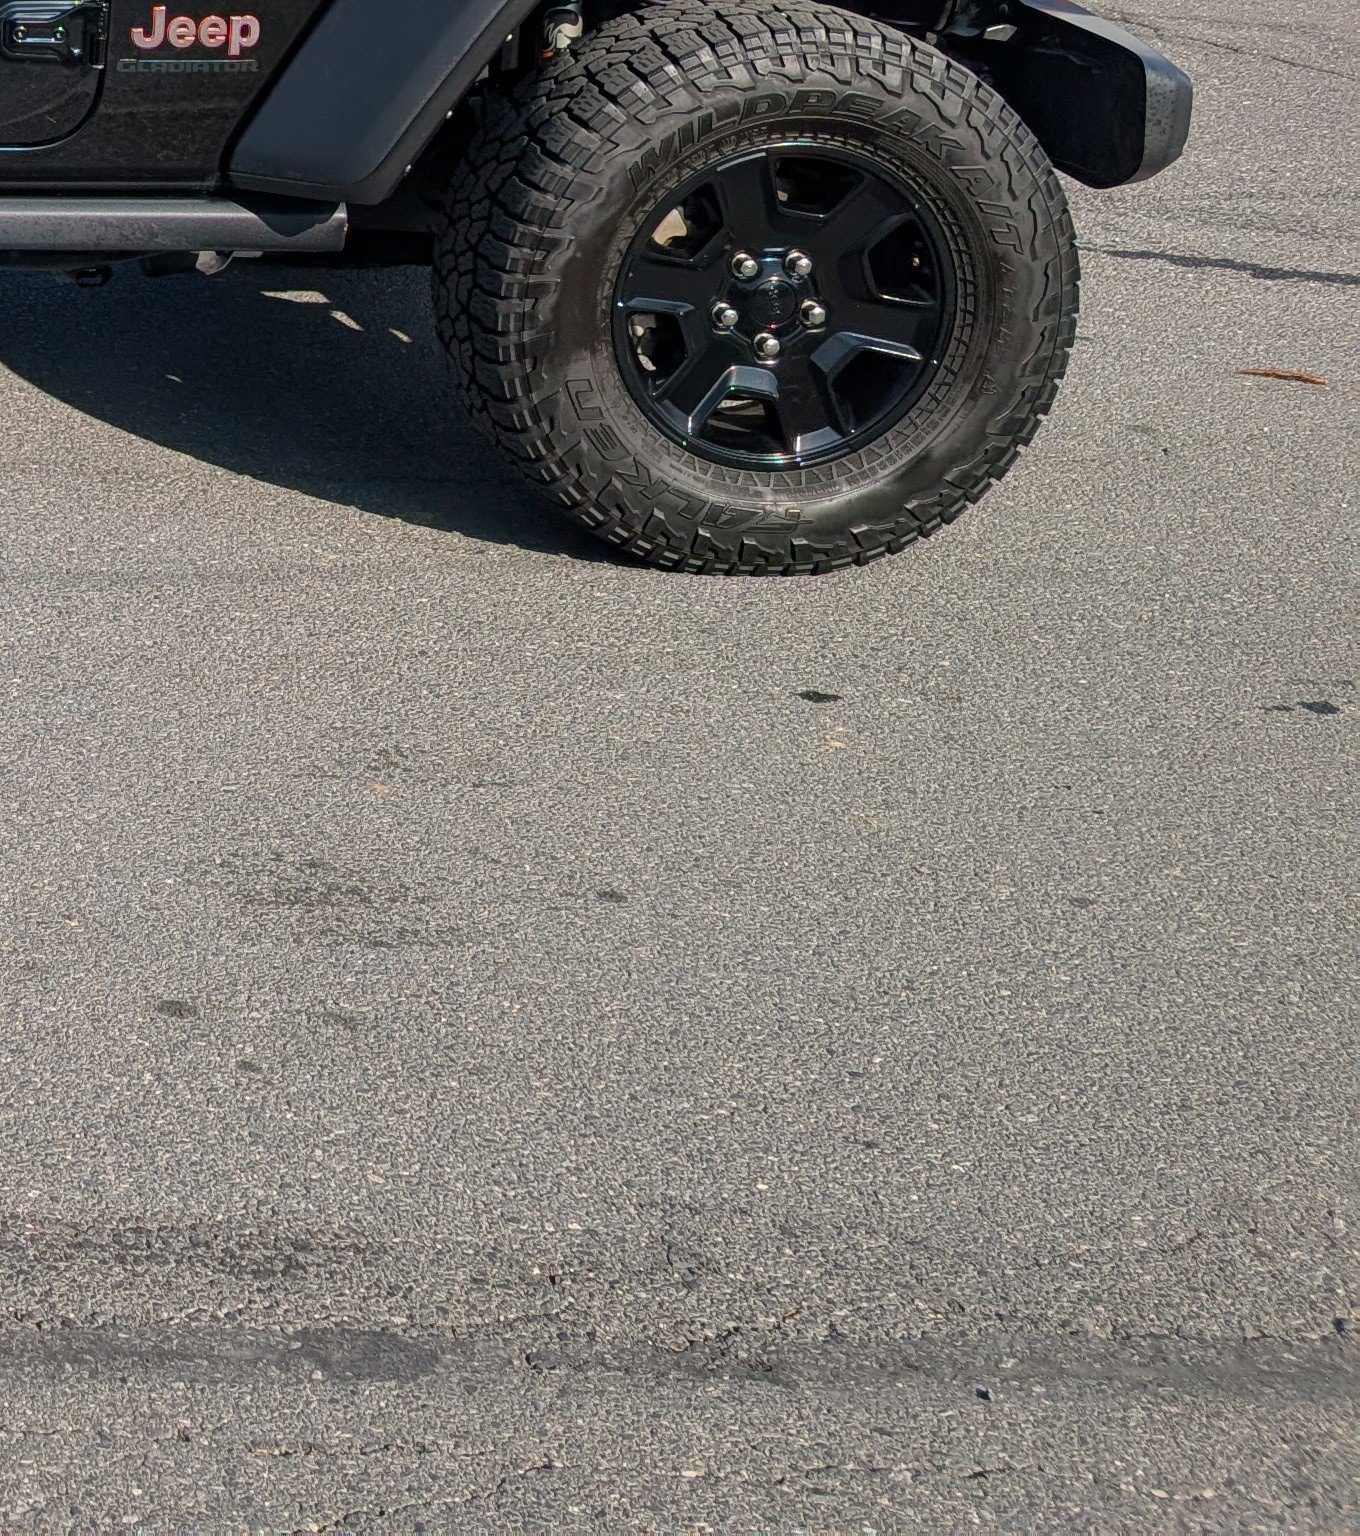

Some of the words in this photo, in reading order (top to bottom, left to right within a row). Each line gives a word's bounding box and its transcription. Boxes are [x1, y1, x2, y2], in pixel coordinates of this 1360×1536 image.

[116, 58, 260, 73] GLADIATOR
[129, 4, 261, 56] Jeep
[627, 88, 967, 191] WILDPEAK
[565, 378, 815, 533] FALKEN
